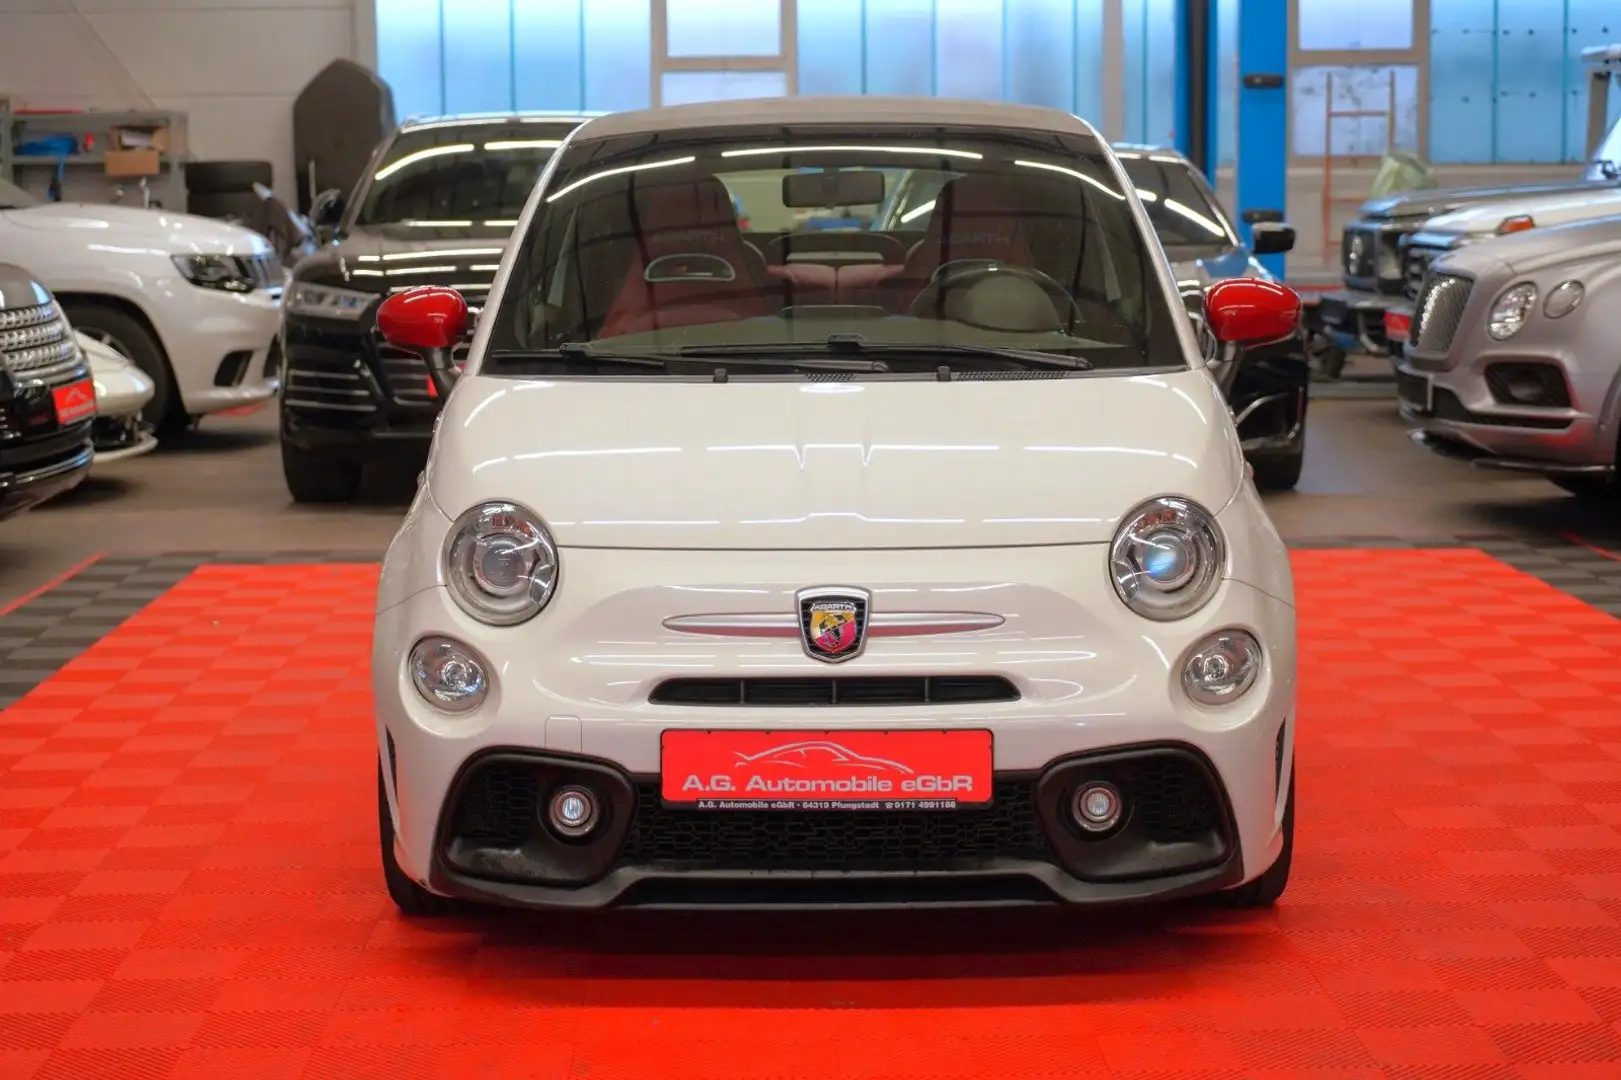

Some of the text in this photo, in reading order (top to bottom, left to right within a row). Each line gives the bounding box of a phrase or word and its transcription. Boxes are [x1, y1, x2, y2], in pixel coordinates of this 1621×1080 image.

[682, 774, 973, 792] A.G. Automobile eGbR
[698, 801, 717, 809] A.G.
[719, 801, 769, 809] Automobile
[770, 801, 795, 809] eGbR
[802, 801, 830, 809] 64319
[831, 801, 879, 811] Pfungstadt
[894, 801, 915, 809] 0171
